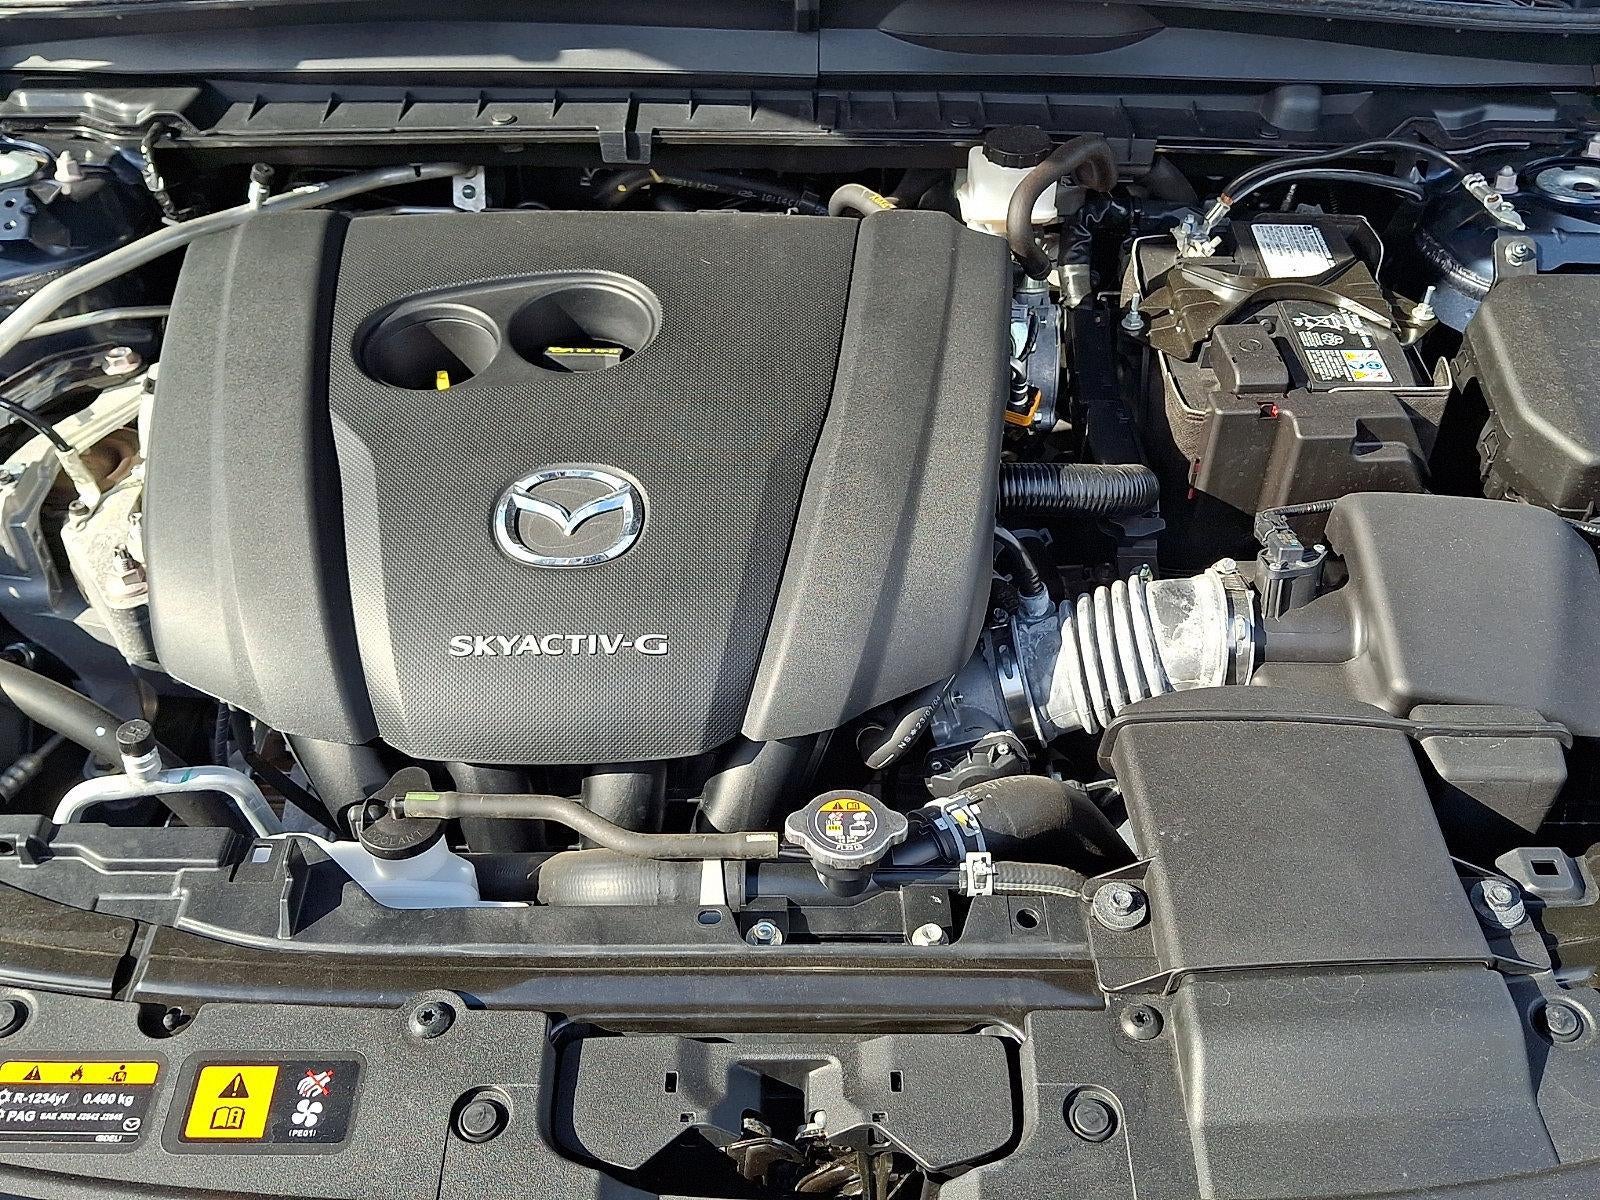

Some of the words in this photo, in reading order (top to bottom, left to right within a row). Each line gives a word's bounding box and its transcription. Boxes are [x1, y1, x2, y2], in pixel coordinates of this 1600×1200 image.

[449, 632, 670, 657] SKYACTIV-G
[367, 829, 423, 846] COOLANT
[13, 1092, 70, 1107] R-1234yf
[117, 1093, 135, 1107] kg
[6, 1110, 36, 1122] PAG
